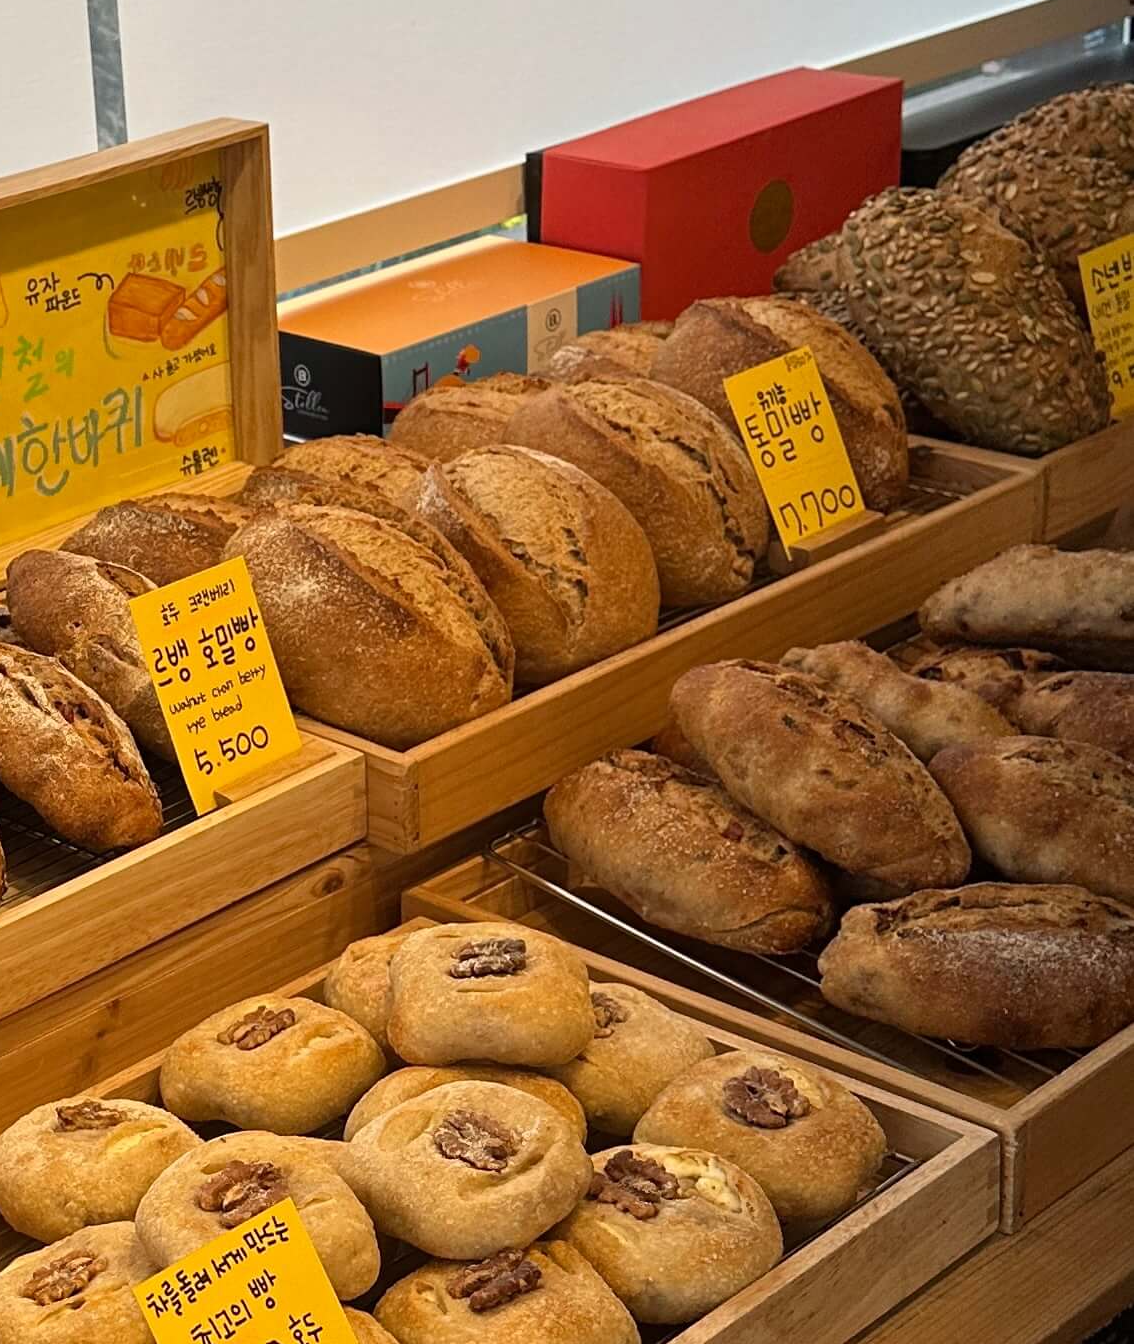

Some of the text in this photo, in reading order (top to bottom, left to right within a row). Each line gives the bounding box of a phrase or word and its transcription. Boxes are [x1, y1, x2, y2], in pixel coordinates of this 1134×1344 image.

[25, 272, 60, 306] 유자
[45, 288, 81, 312] 파운드
[744, 391, 824, 468] 통밀빵
[779, 484, 856, 536] 7.700
[160, 578, 236, 627] 호두 크랜베리
[152, 607, 259, 687] 르뱅 호밀빵
[186, 695, 243, 734] rye bread
[194, 725, 269, 775] 5.500
[247, 1269, 277, 1309] 빵
